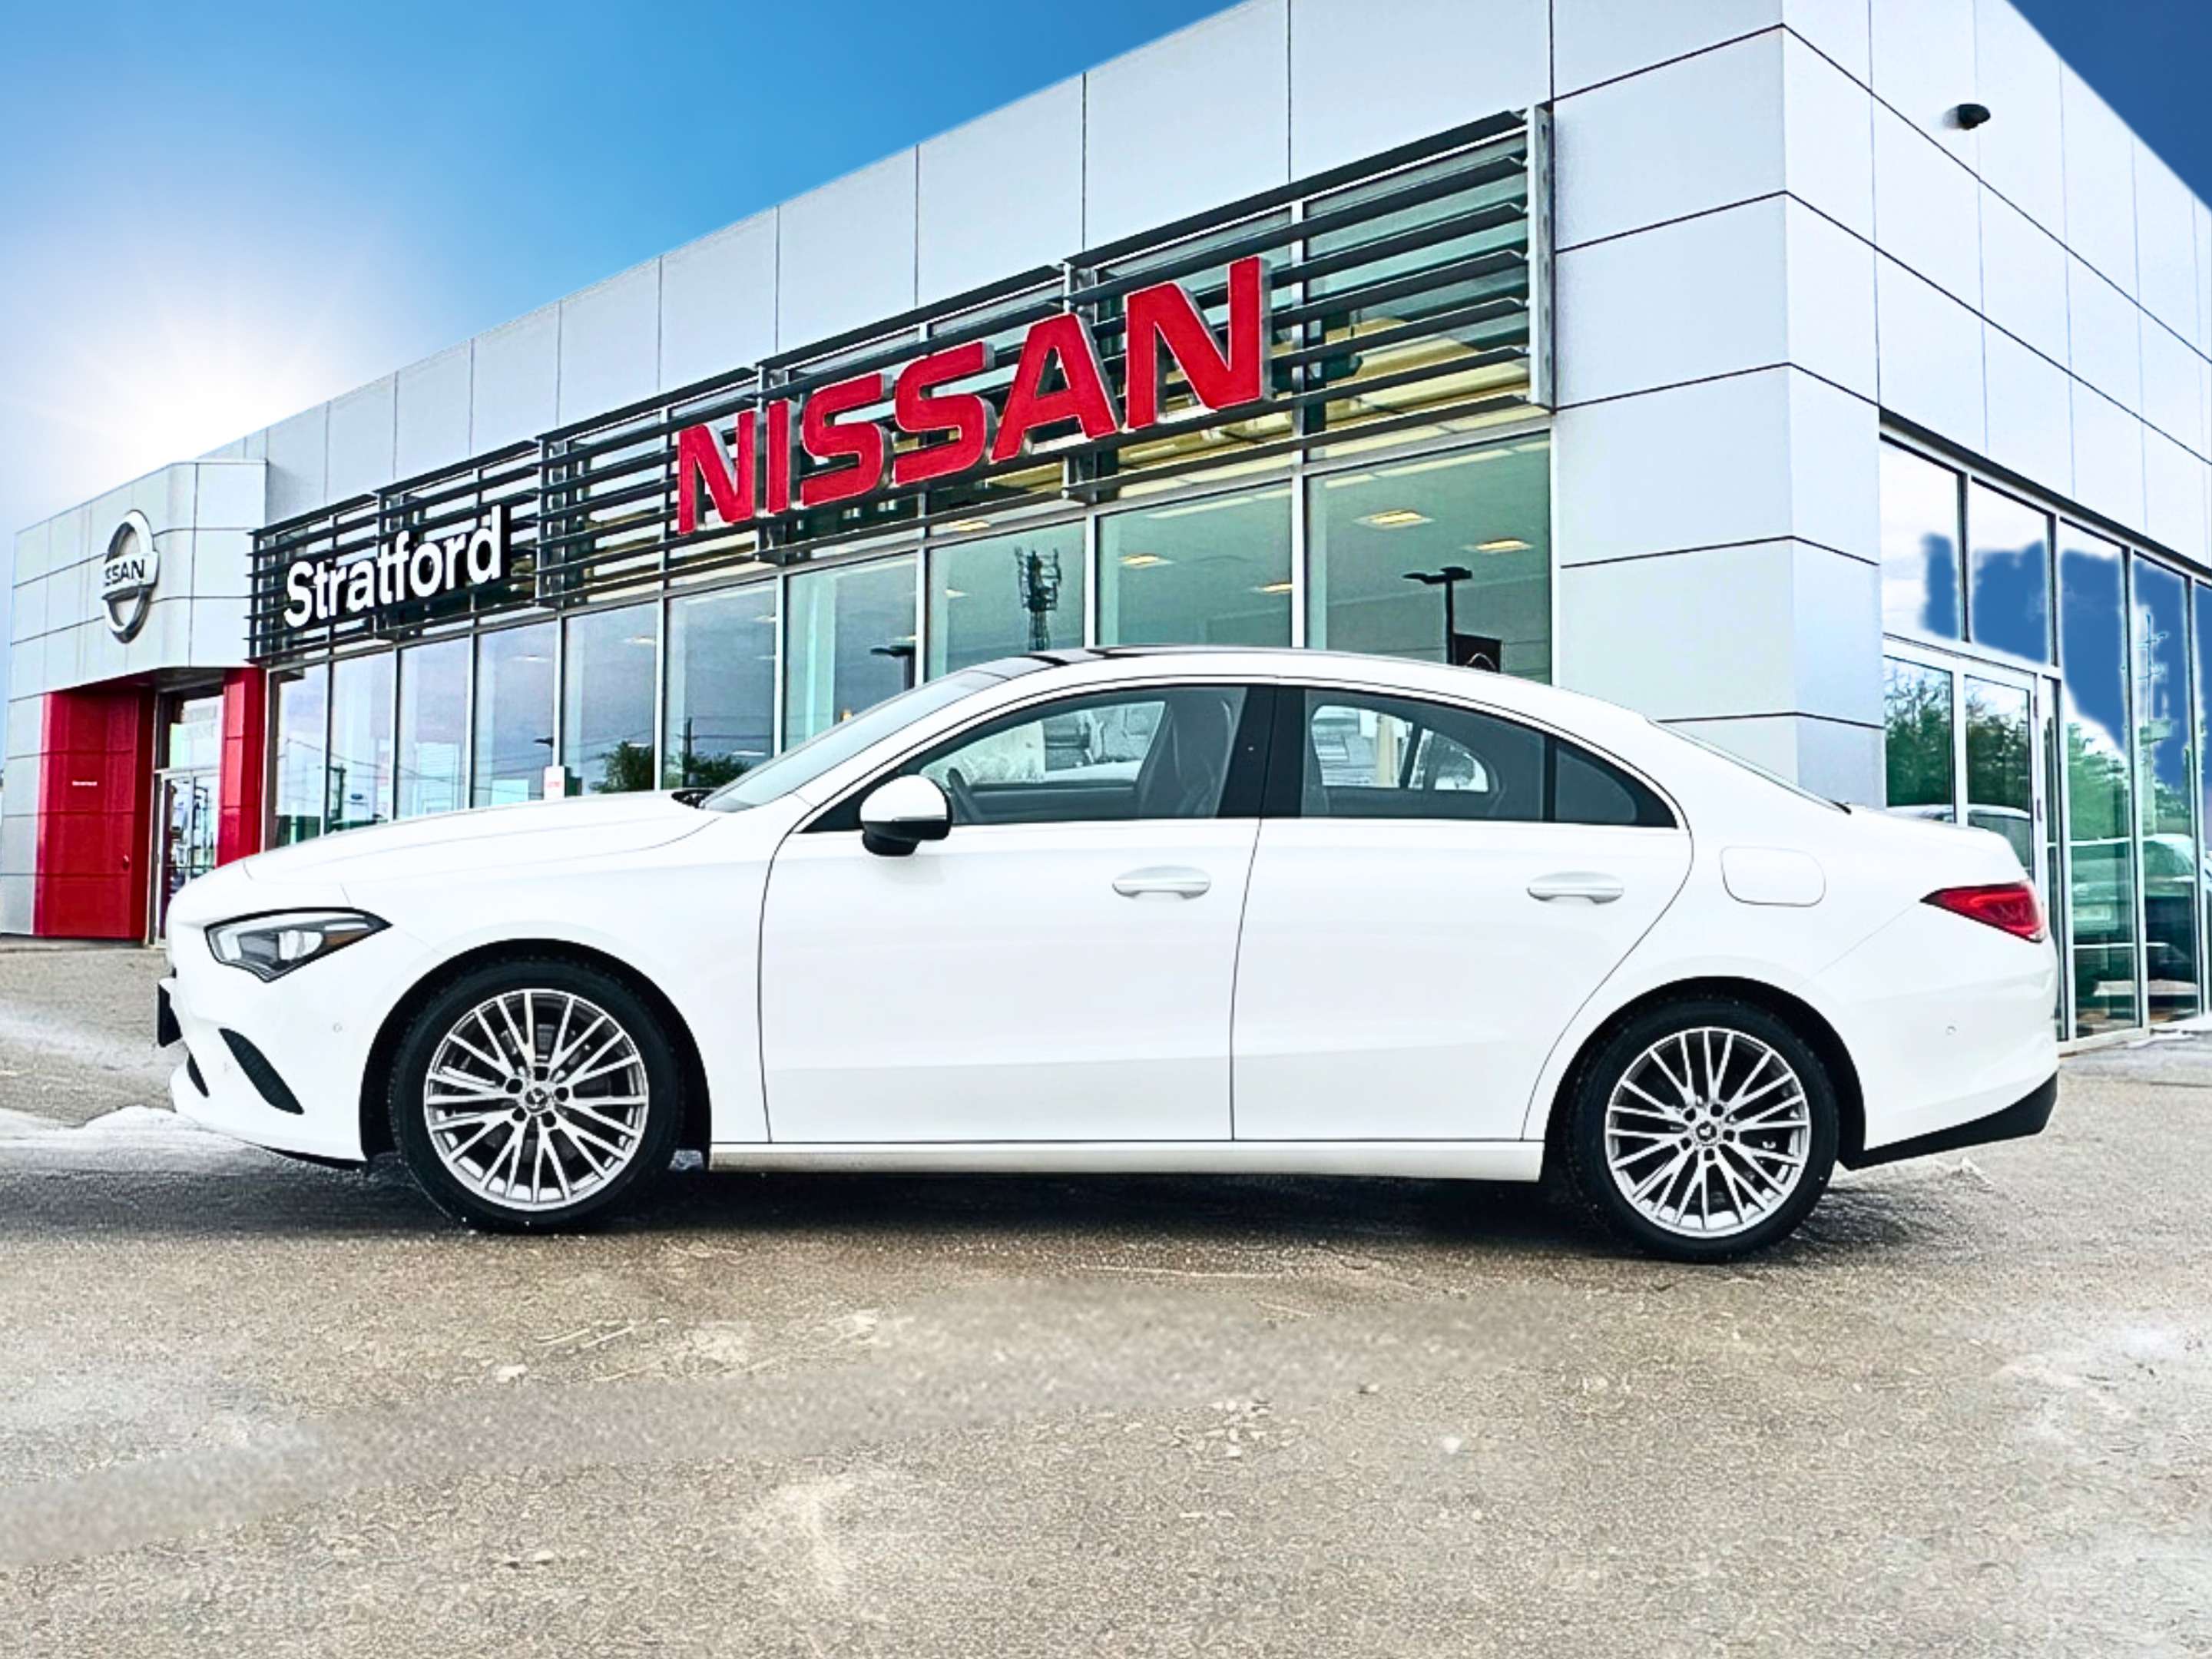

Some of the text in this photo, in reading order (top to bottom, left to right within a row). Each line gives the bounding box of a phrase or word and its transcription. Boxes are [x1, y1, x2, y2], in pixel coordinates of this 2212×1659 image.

[677, 255, 1267, 535] NISSAN
[104, 558, 145, 587] SSAN
[284, 504, 502, 628] Stratford
